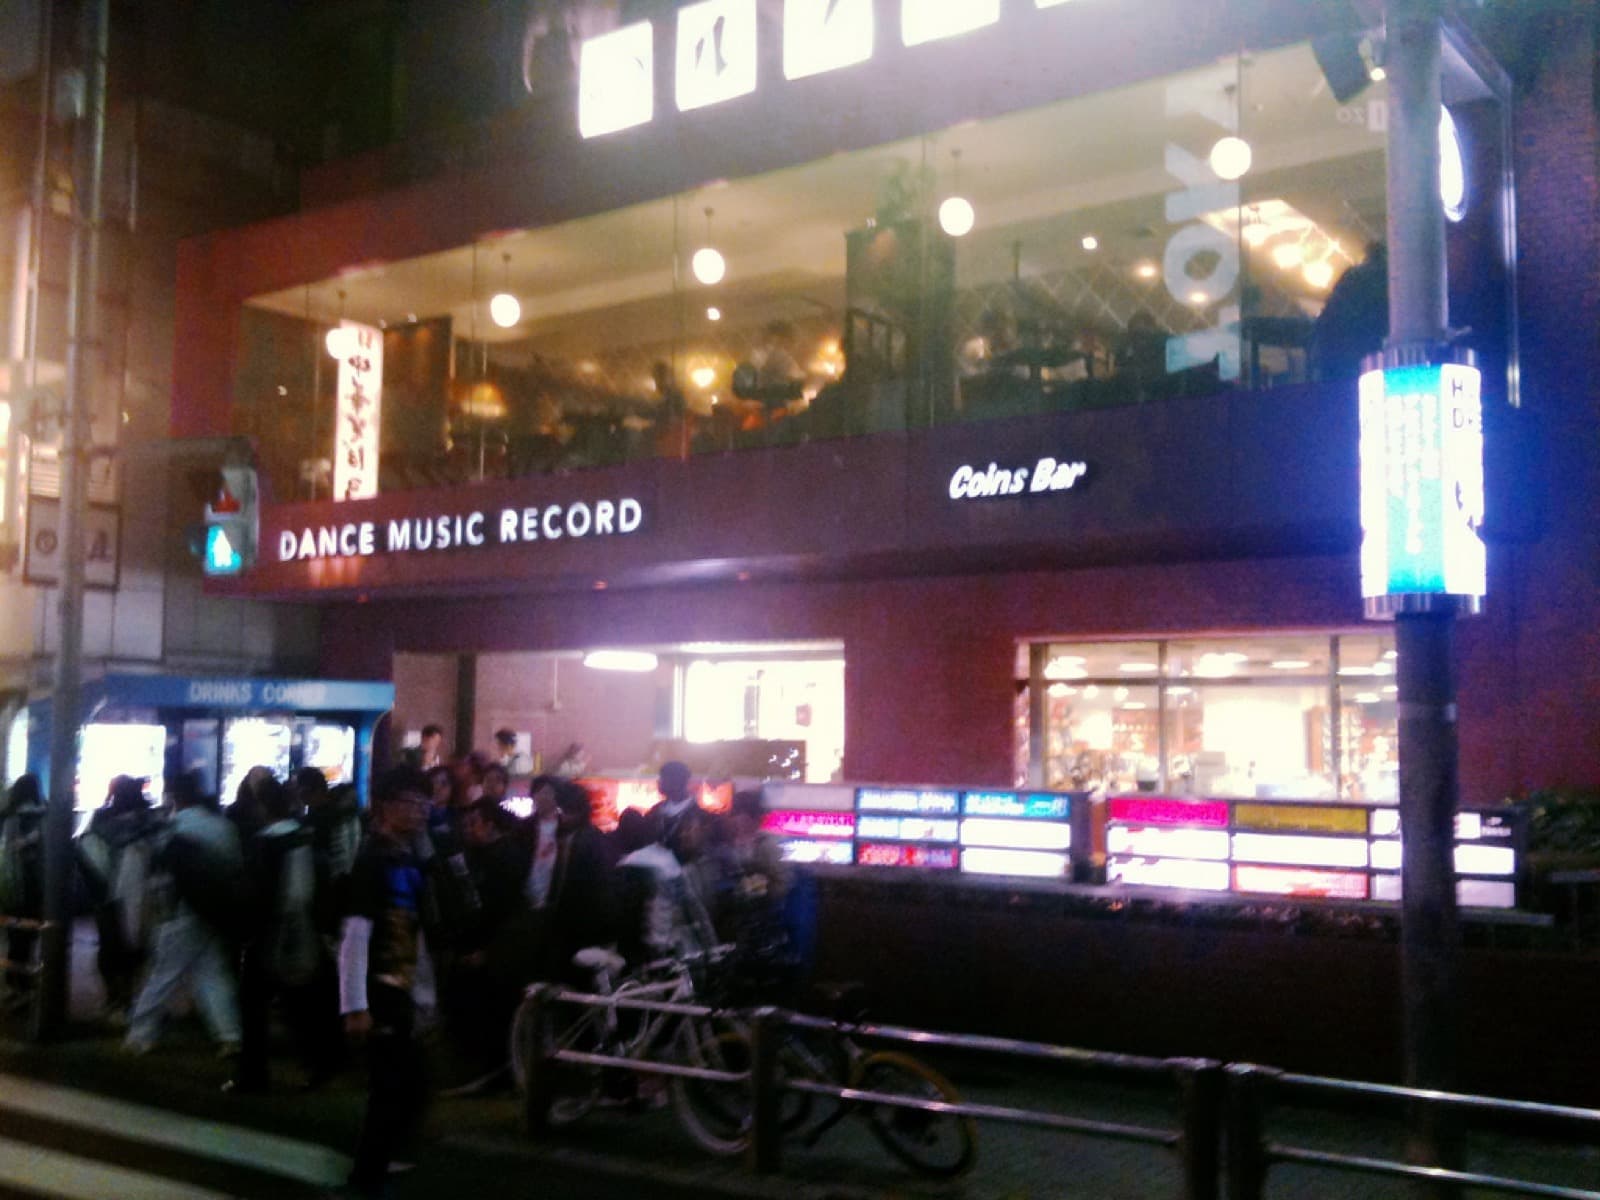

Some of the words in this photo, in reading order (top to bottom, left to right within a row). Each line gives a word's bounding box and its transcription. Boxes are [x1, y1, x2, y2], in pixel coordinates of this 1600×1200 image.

[949, 462, 1029, 499] Coins
[1030, 457, 1087, 492] Bar
[279, 521, 375, 562] DANCE
[387, 511, 485, 551] MUSIC
[500, 497, 642, 543] RECORD
[262, 681, 327, 705] COR
